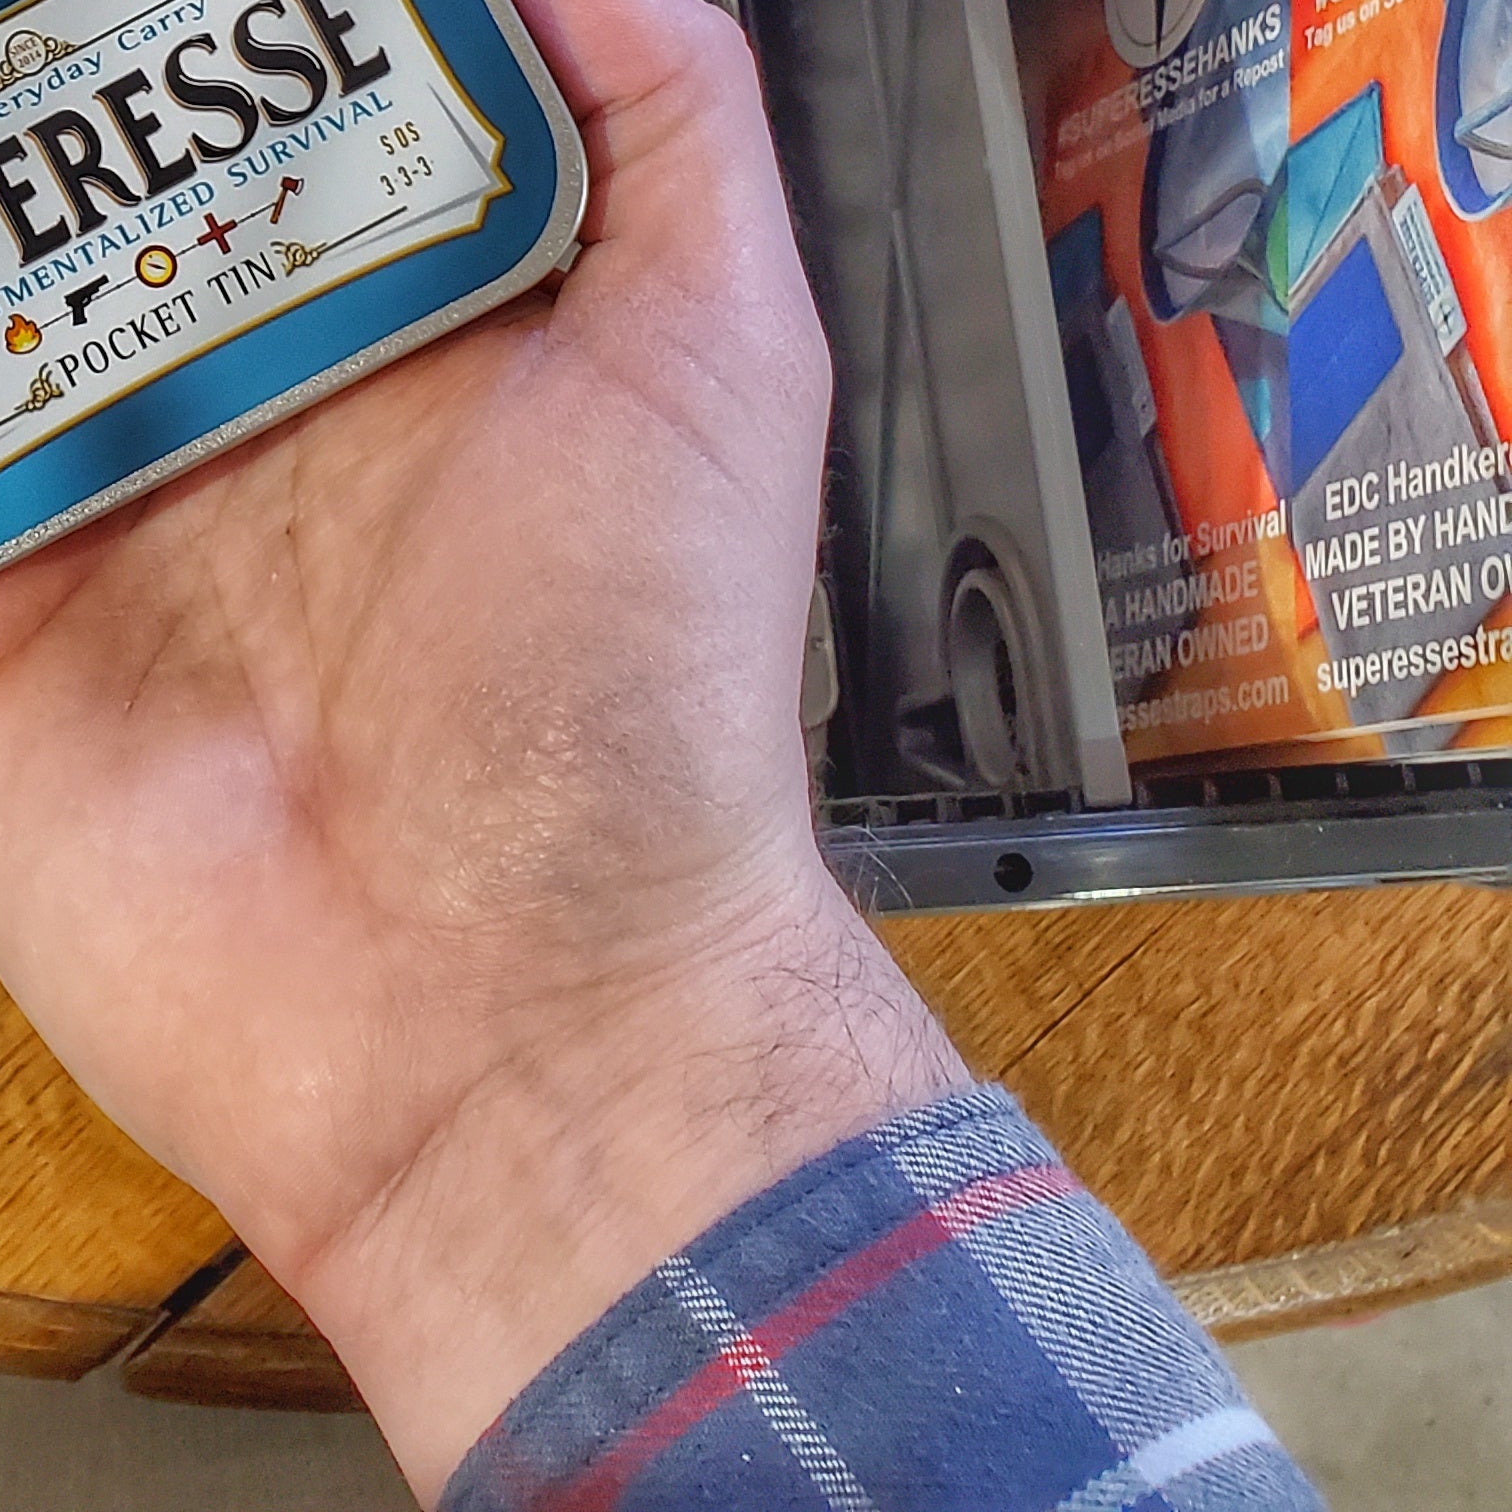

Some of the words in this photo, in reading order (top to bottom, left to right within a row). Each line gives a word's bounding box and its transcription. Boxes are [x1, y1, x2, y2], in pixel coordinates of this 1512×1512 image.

[9, 37, 39, 57] SINCE
[16, 51, 43, 69] 2014
[1304, 20, 1335, 51] Tag
[1336, 13, 1356, 35] us
[1197, 85, 1219, 111] for
[1221, 82, 1230, 100] a
[1234, 48, 1286, 91] Repost
[227, 90, 394, 186] SURVIVAL
[379, 121, 420, 156] SOS
[56, 289, 196, 388] POCKET
[207, 252, 280, 304] TIN
[1324, 472, 1381, 522] EDC
[1387, 440, 1512, 506] Handker
[1163, 531, 1192, 565] for
[1196, 499, 1287, 557] Survival
[1304, 527, 1382, 581] MADE
[1388, 513, 1427, 561] BY
[1434, 491, 1512, 550] HAND
[1125, 560, 1260, 627] HANDMADE
[1331, 562, 1472, 631] VETERAN
[1178, 613, 1270, 669] OWNED
[1316, 623, 1512, 699] superessestra
